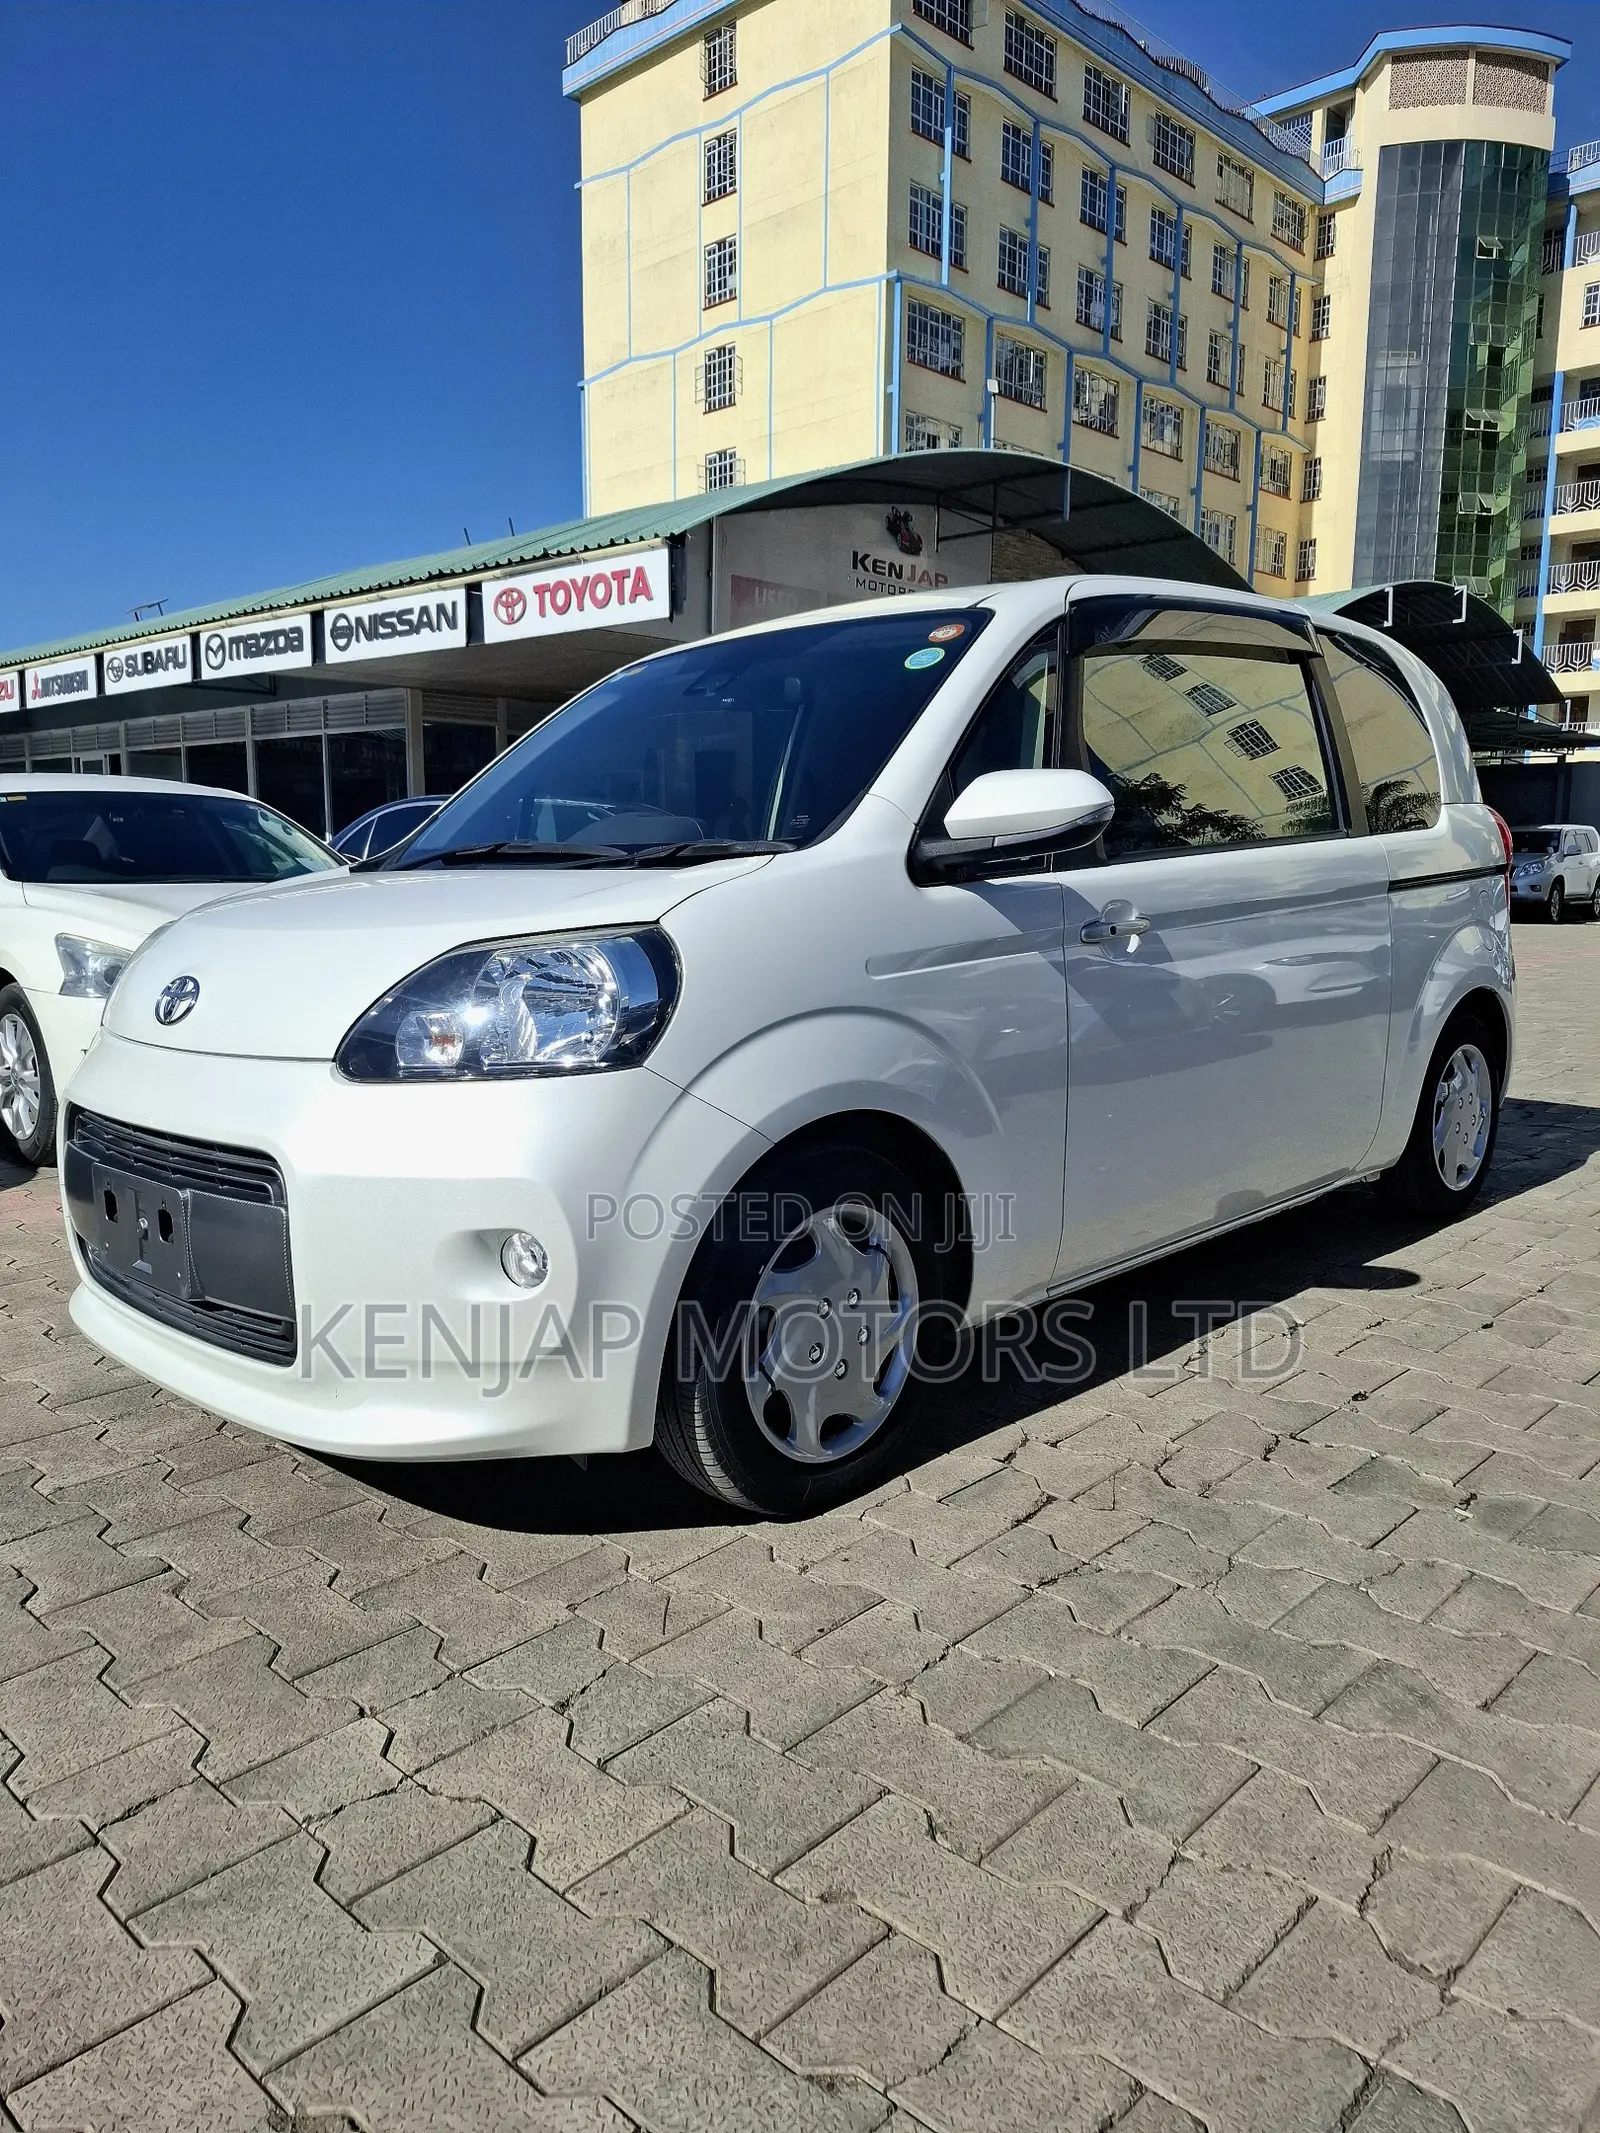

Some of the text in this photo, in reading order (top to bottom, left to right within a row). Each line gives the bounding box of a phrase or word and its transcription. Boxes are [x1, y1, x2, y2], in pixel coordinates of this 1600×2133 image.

[852, 551, 948, 588] KENJAP
[533, 566, 653, 617] TOYOTA
[355, 601, 457, 642] NISSAN
[125, 643, 187, 678] SUBARU
